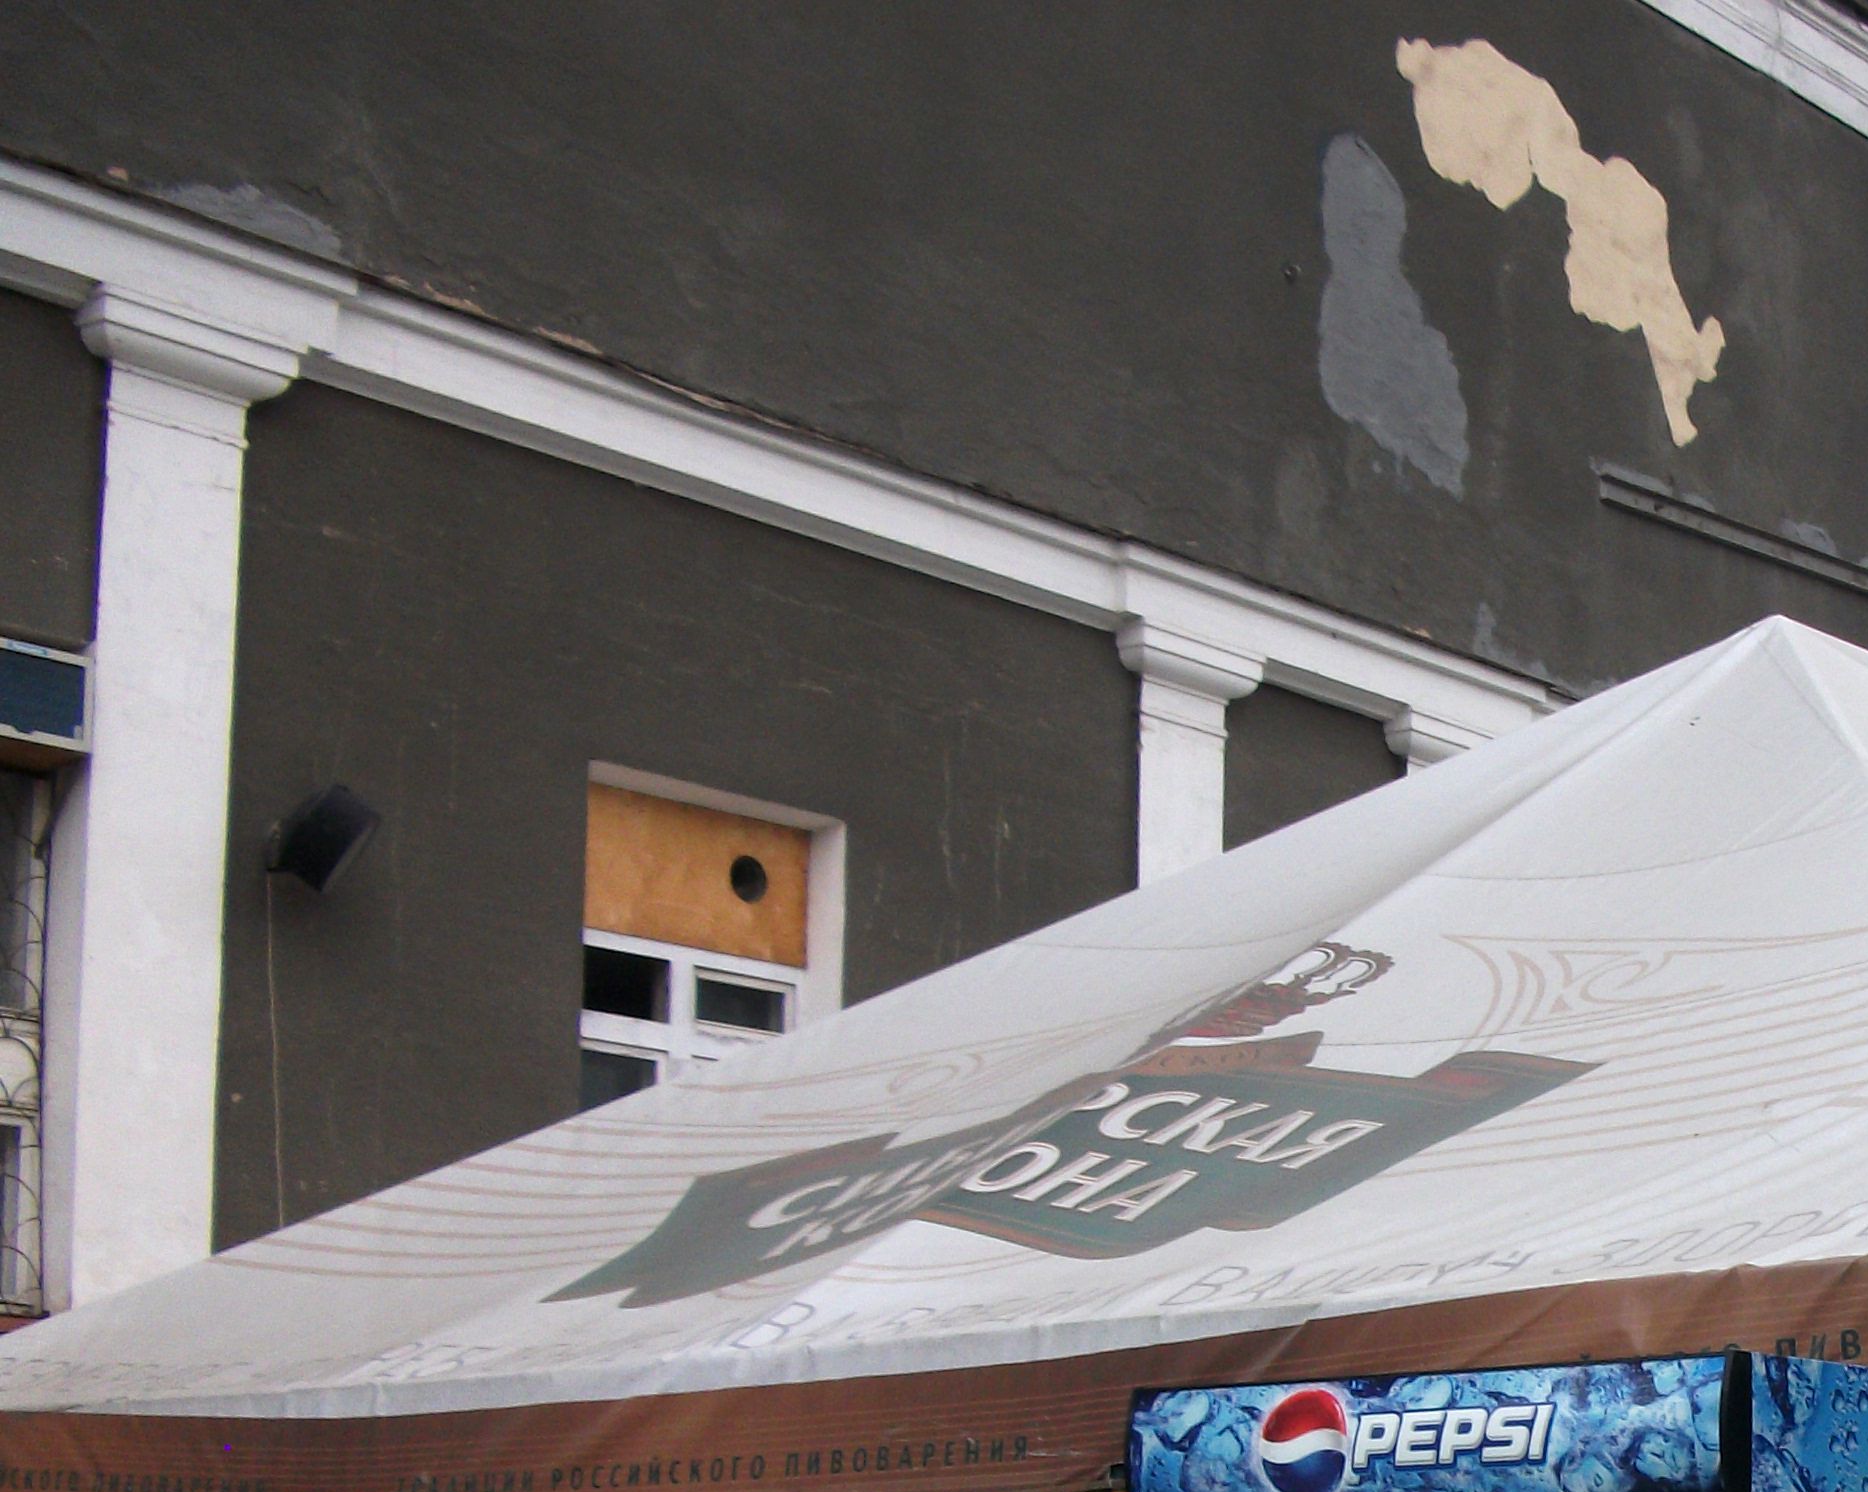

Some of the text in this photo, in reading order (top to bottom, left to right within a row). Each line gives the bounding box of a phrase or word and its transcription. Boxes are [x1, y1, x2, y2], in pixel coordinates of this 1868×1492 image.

[551, 1455, 766, 1491] РОССИЙСКОГО
[785, 1435, 1030, 1477] ПИВОВАРЕНИЯ
[1353, 1404, 1553, 1468] PEPSI
